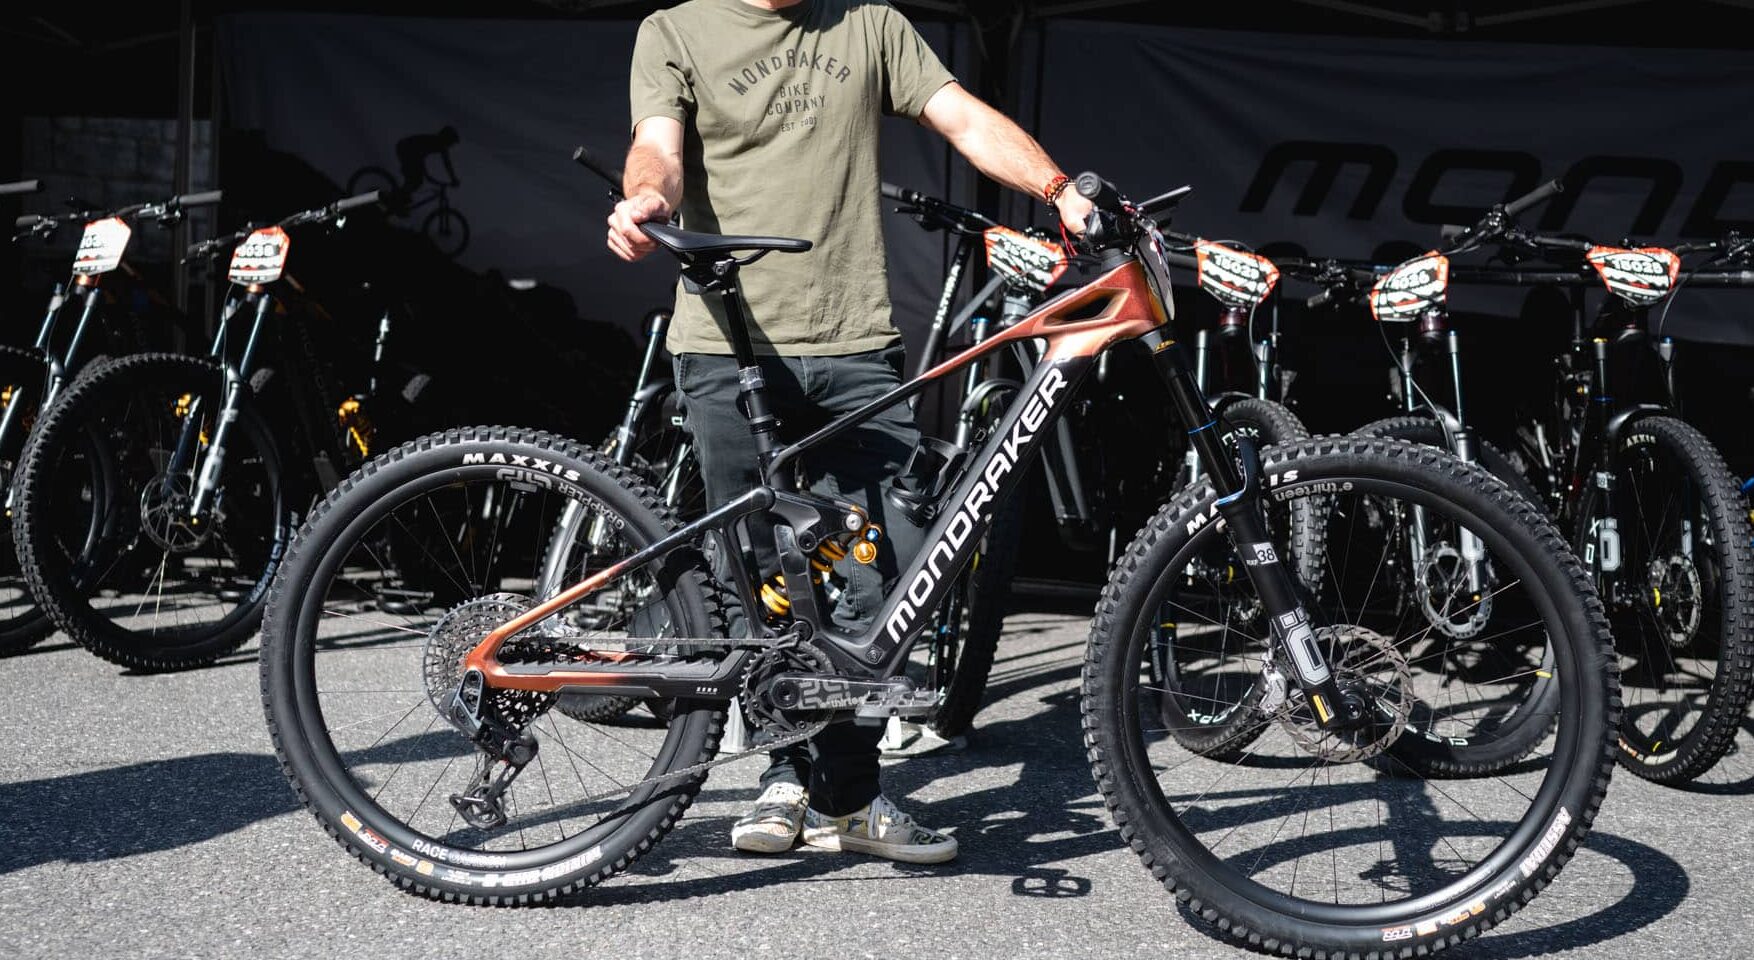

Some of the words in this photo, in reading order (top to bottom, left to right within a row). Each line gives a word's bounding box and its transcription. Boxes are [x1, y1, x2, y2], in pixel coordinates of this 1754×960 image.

[728, 49, 851, 95] MONDRAKER
[779, 82, 810, 98] BIKE
[767, 95, 826, 115] COMPANY
[781, 121, 795, 133] EST
[462, 453, 581, 481] MAXXIS
[558, 482, 625, 530] GRAPPLER
[886, 368, 1067, 644] MONDRAKER
[1257, 547, 1275, 563] 38
[412, 838, 449, 860] RACE
